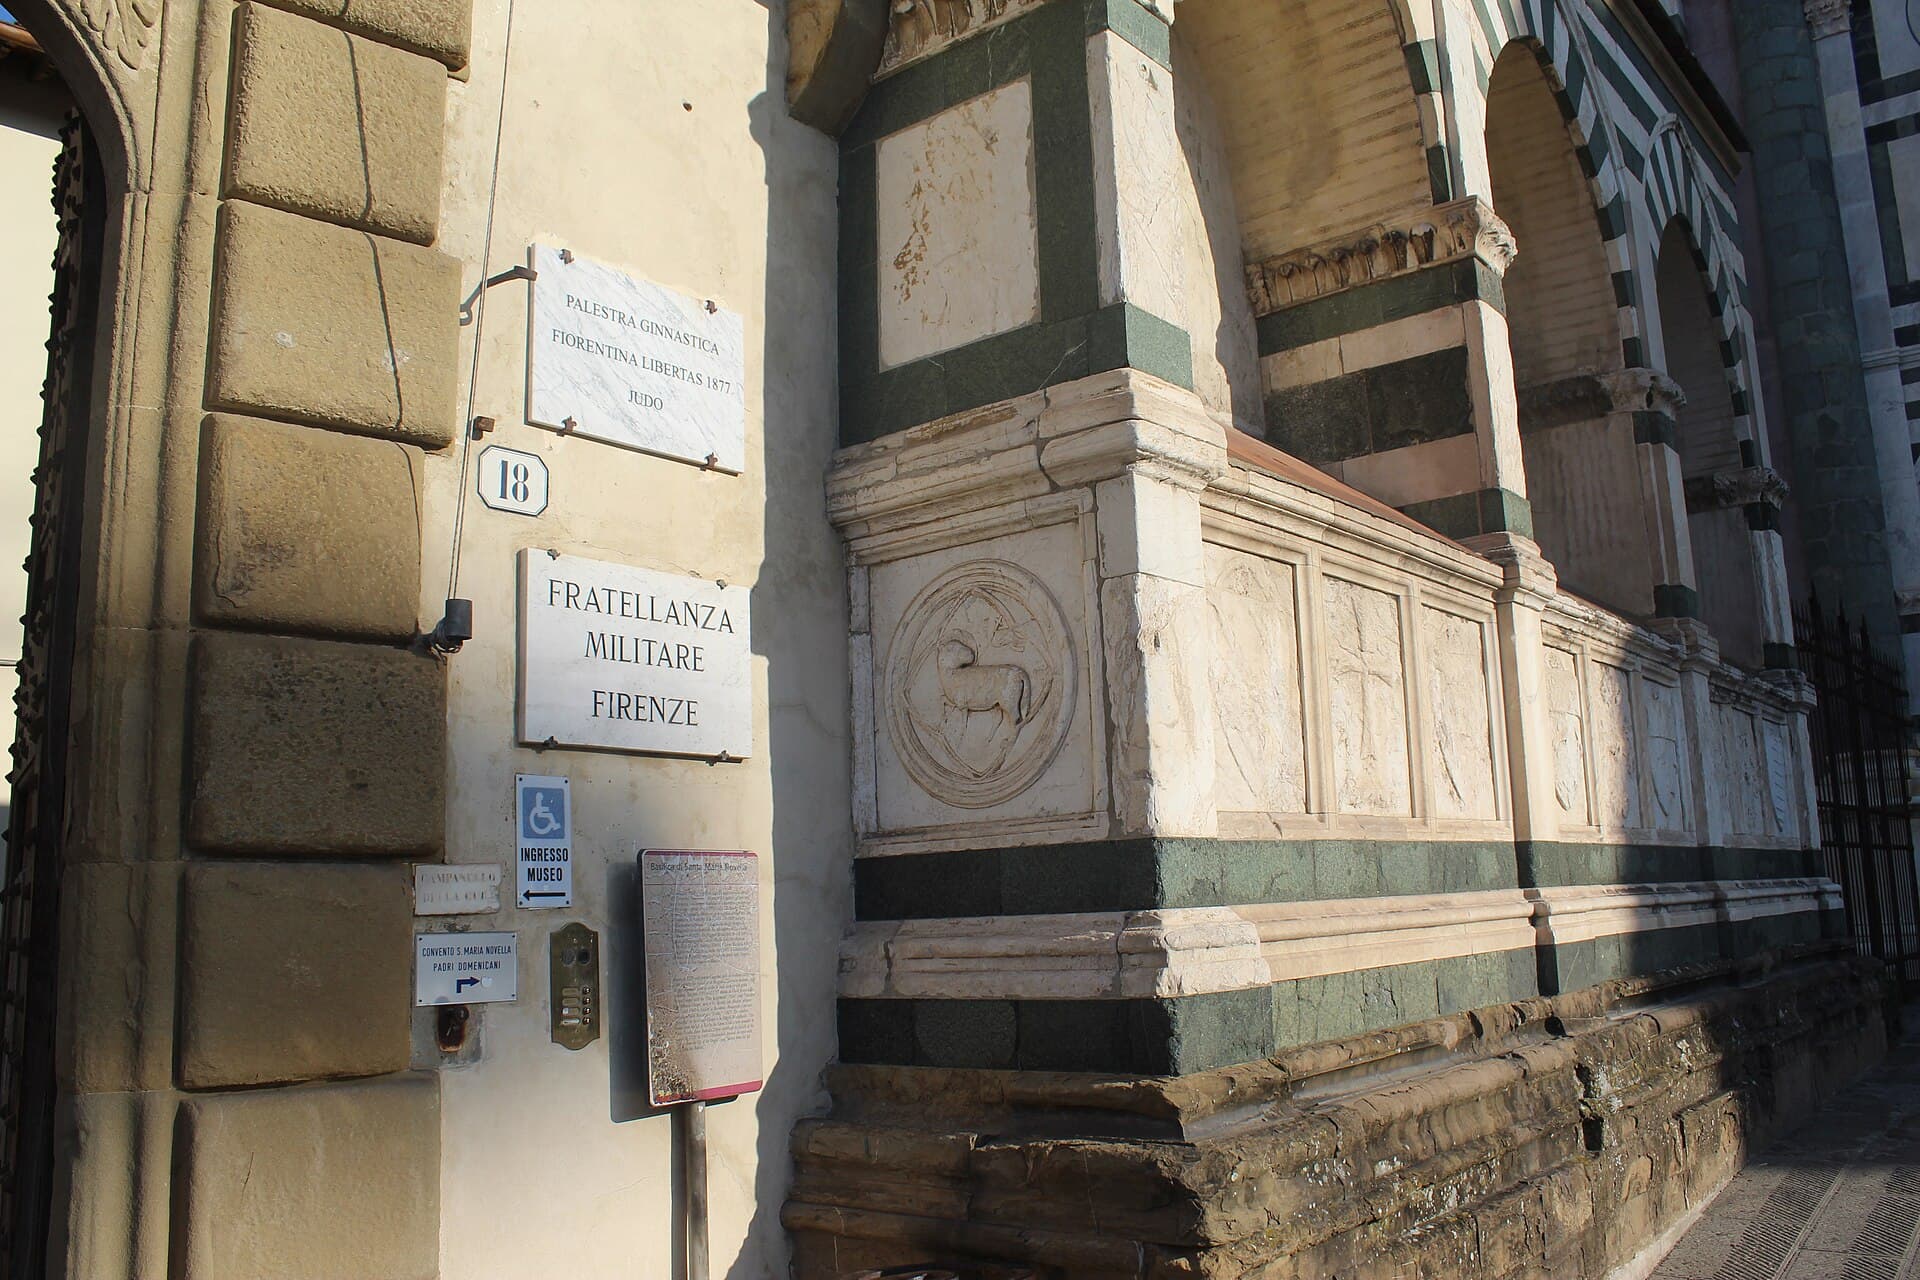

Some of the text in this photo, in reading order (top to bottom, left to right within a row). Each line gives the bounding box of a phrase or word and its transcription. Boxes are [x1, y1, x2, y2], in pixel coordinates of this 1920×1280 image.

[566, 294, 719, 356] PALESTRA GINNASTICA
[552, 328, 731, 394] FIORENTINA LIBERTAS 1877
[628, 390, 663, 411] JUDO
[499, 459, 529, 503] 18
[548, 578, 735, 634] FRATELLANZA
[584, 630, 705, 672] MILITARE
[592, 690, 699, 727] FIRENZE
[520, 847, 569, 862] INGRESSO
[527, 867, 563, 882] MUSEO
[422, 946, 455, 957] CONVENTO
[463, 945, 484, 956] MARIA
[485, 945, 512, 955] NOVELLA
[433, 960, 501, 972] PADRI DOMENICANI
